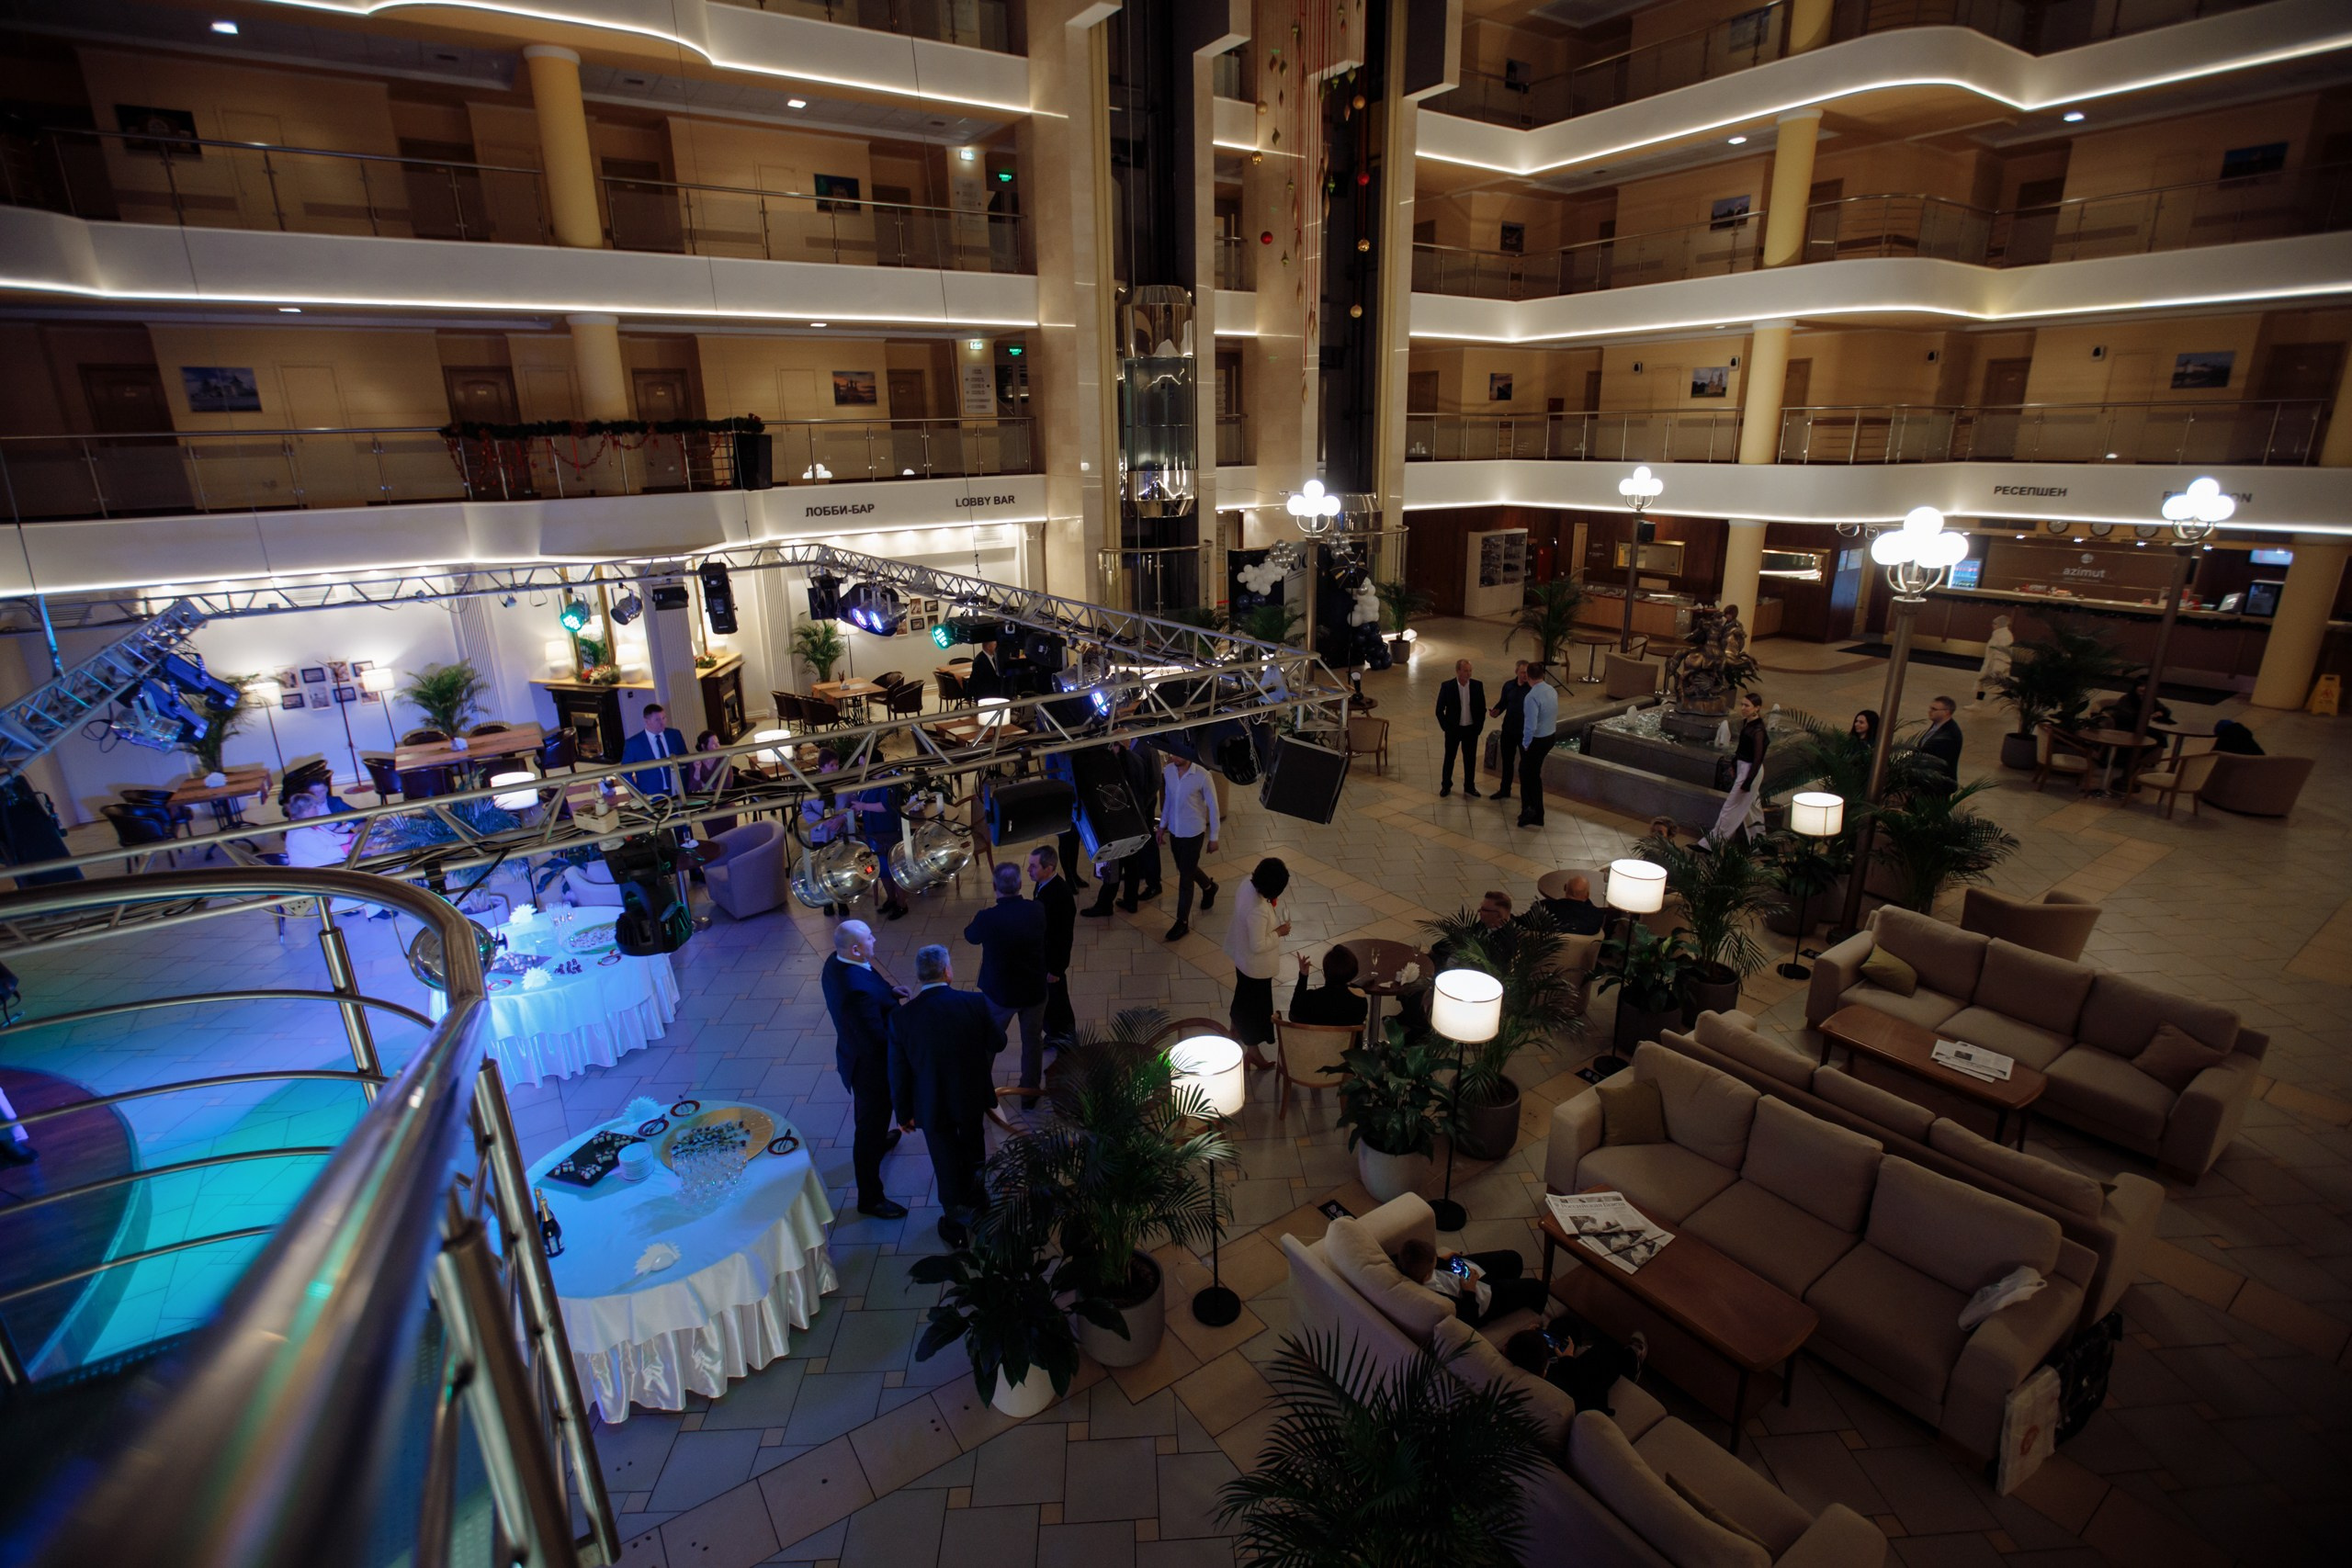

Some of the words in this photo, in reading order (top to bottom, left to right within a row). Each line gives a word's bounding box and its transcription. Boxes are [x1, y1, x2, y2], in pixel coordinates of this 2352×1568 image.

[1993, 485, 2067, 497] РЕСЕПШЕН
[956, 496, 990, 507] LOBBY
[993, 494, 1015, 505] BAR
[805, 503, 875, 517] ЛОББИ-БАР
